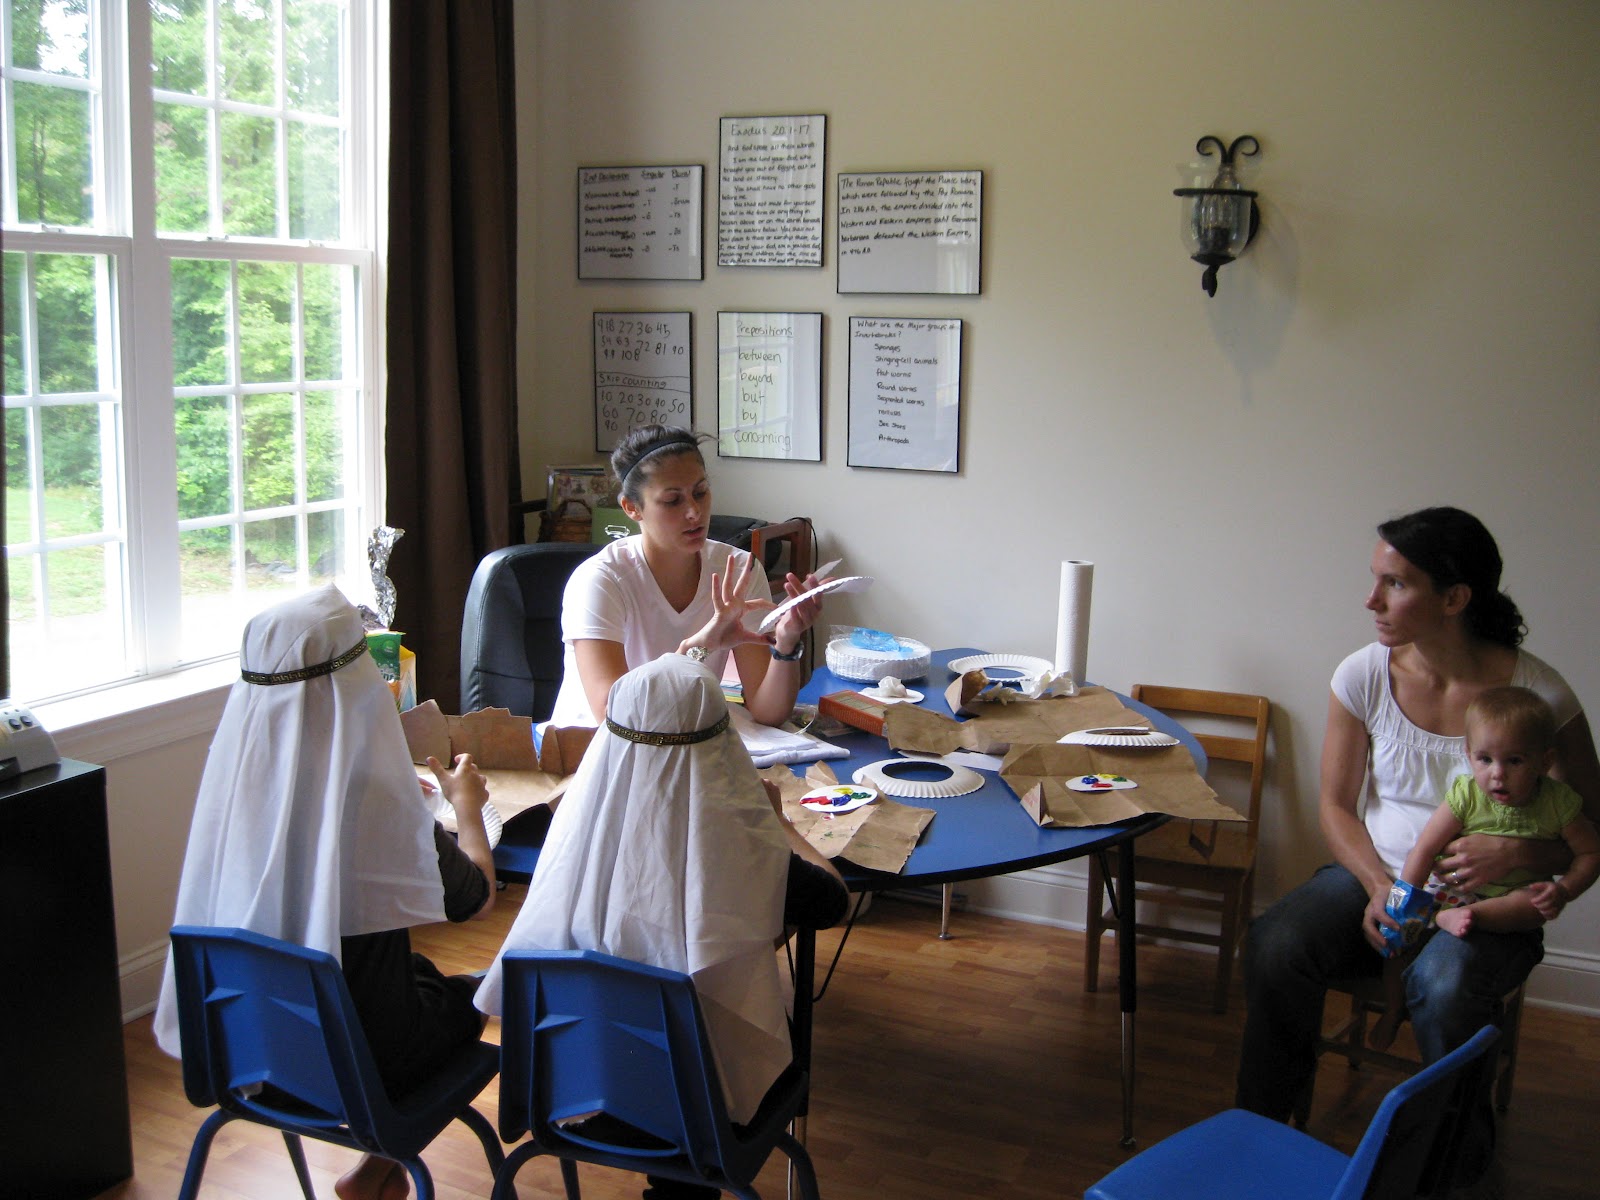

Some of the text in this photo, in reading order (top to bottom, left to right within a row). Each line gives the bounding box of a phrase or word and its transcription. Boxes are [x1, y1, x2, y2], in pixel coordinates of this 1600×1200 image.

[731, 124, 766, 136] Exodus
[771, 125, 785, 136] 20
[842, 177, 853, 189] The
[856, 178, 874, 187] Roman
[904, 176, 924, 188] fought
[938, 176, 958, 184] Punic
[910, 190, 920, 199] by
[619, 320, 634, 334] 27
[637, 321, 653, 336] 36
[656, 322, 670, 338] 45
[616, 336, 630, 347] 63
[636, 340, 650, 352] 72
[655, 342, 666, 355] 81
[672, 346, 684, 355] 90
[874, 343, 901, 353] Sponges
[622, 348, 641, 361] 108
[738, 346, 782, 363] between
[739, 368, 773, 387] beyond
[877, 382, 896, 391] Round
[601, 390, 613, 402] 10
[619, 392, 634, 404] 20
[638, 394, 651, 406] 30
[668, 399, 685, 413] 50
[742, 388, 766, 406] but
[602, 404, 667, 424] 60 70 80
[742, 409, 757, 424] by
